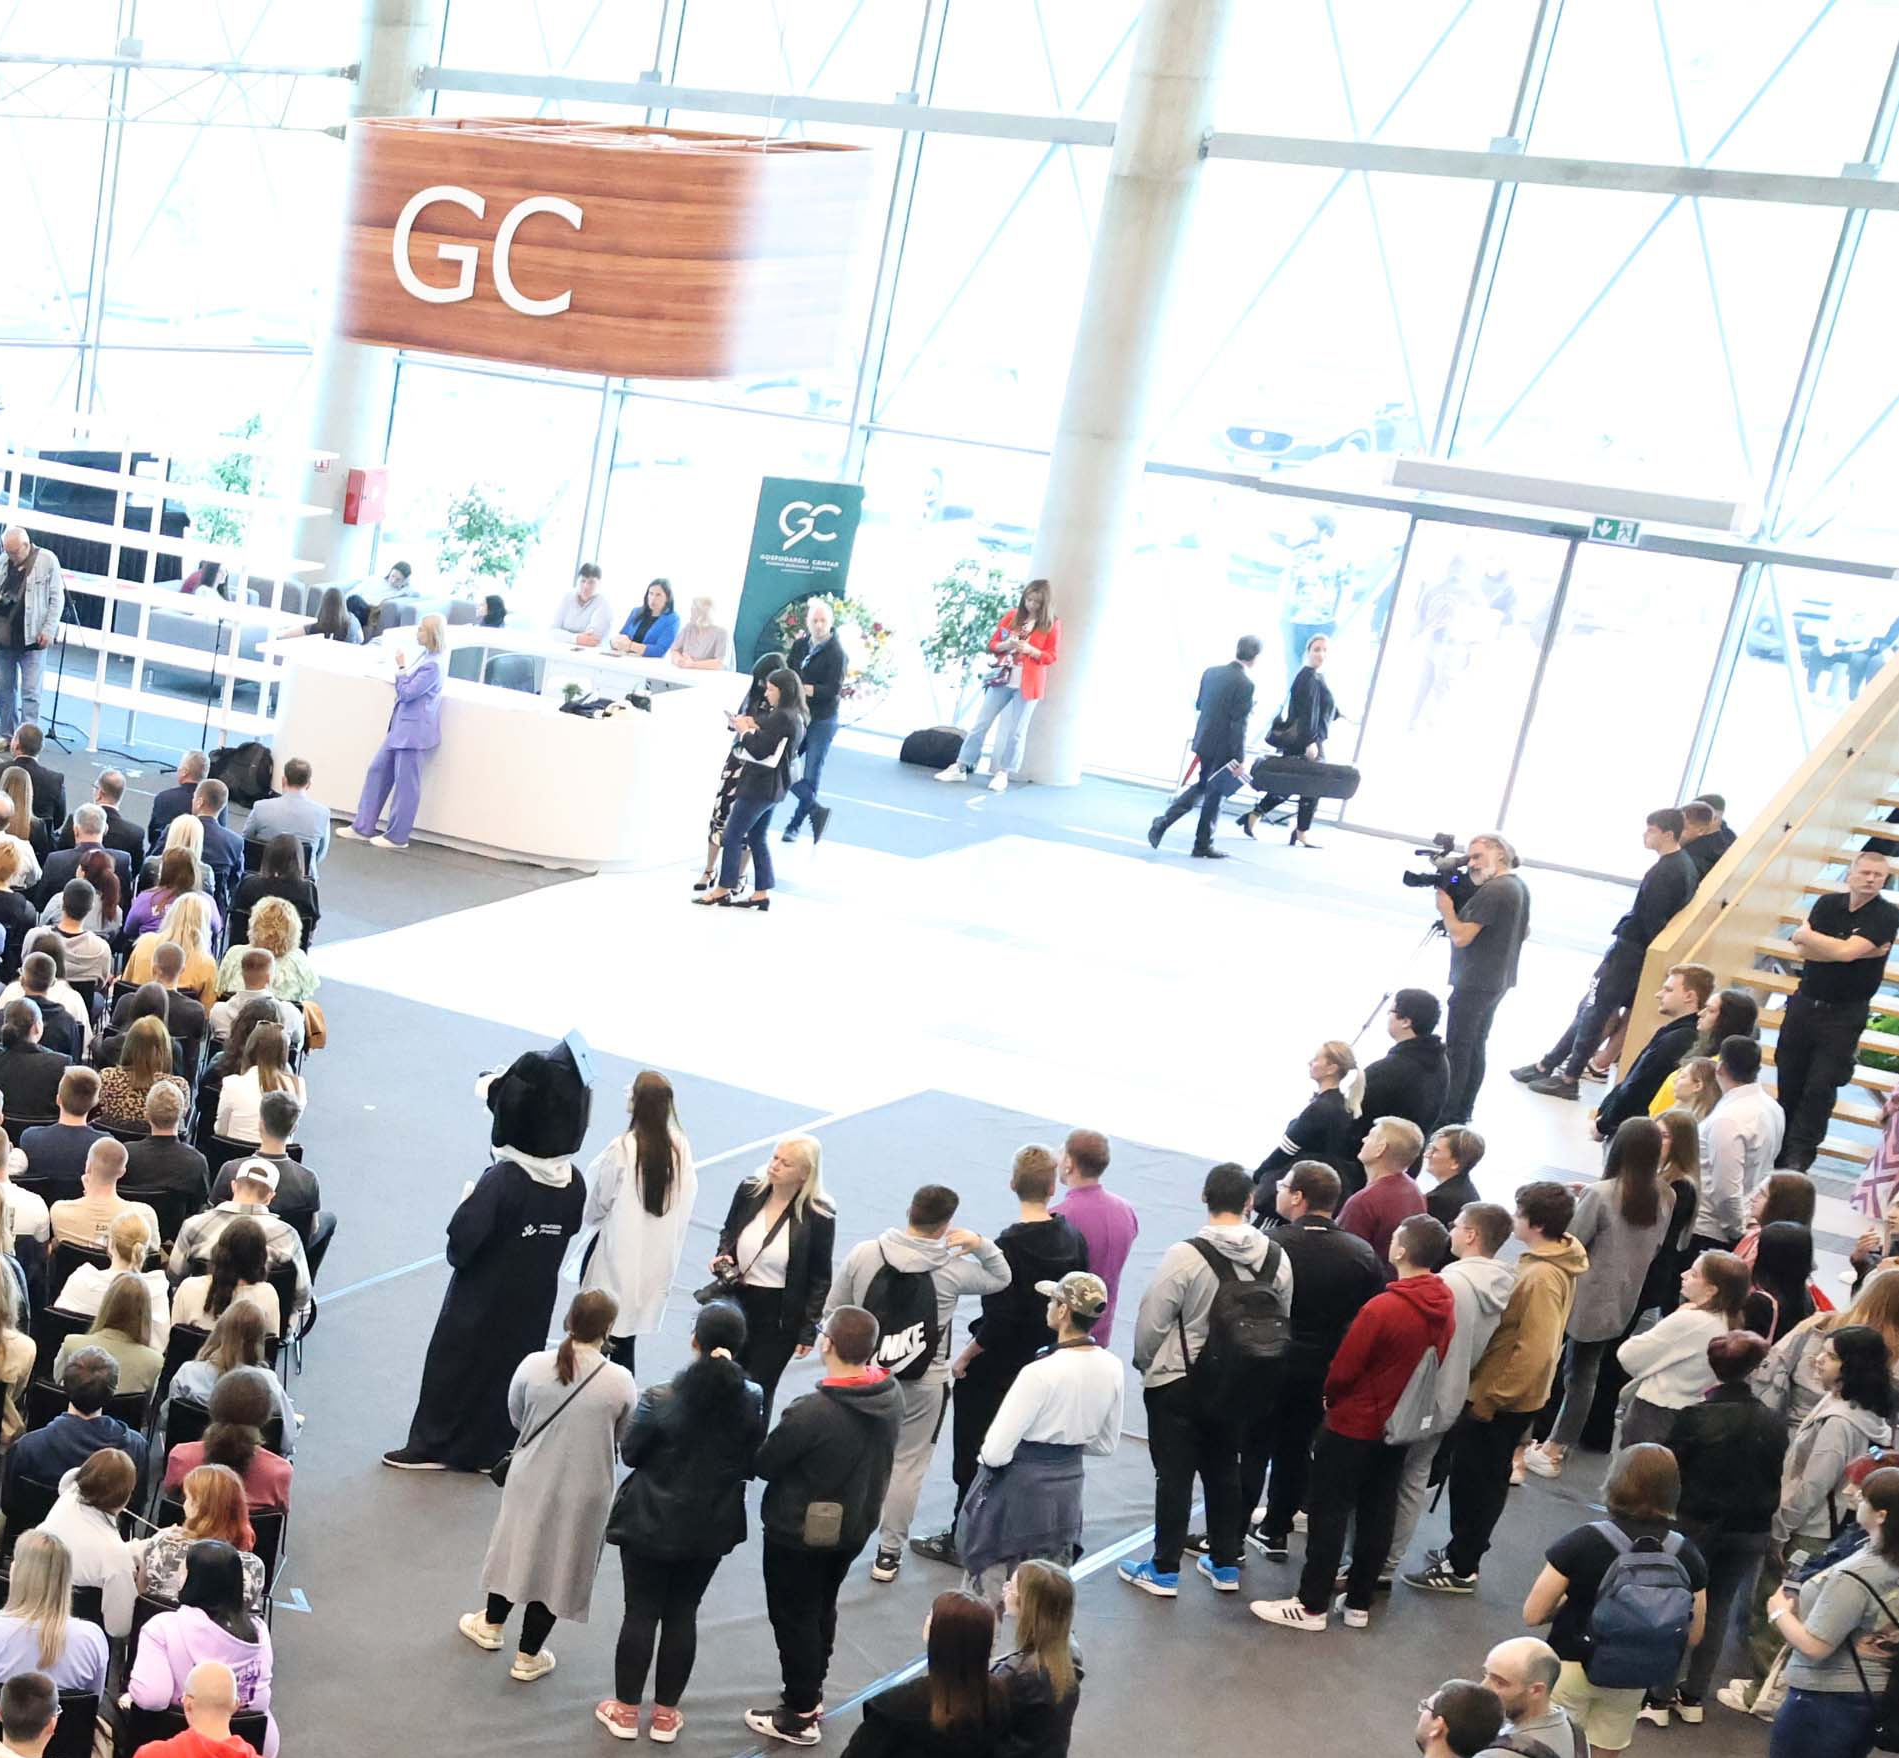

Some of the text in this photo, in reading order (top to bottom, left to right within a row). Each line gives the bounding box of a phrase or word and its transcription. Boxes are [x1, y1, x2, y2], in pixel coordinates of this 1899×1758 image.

[392, 184, 584, 317] GC
[778, 500, 843, 552] GC
[878, 1320, 925, 1361] NIKE
